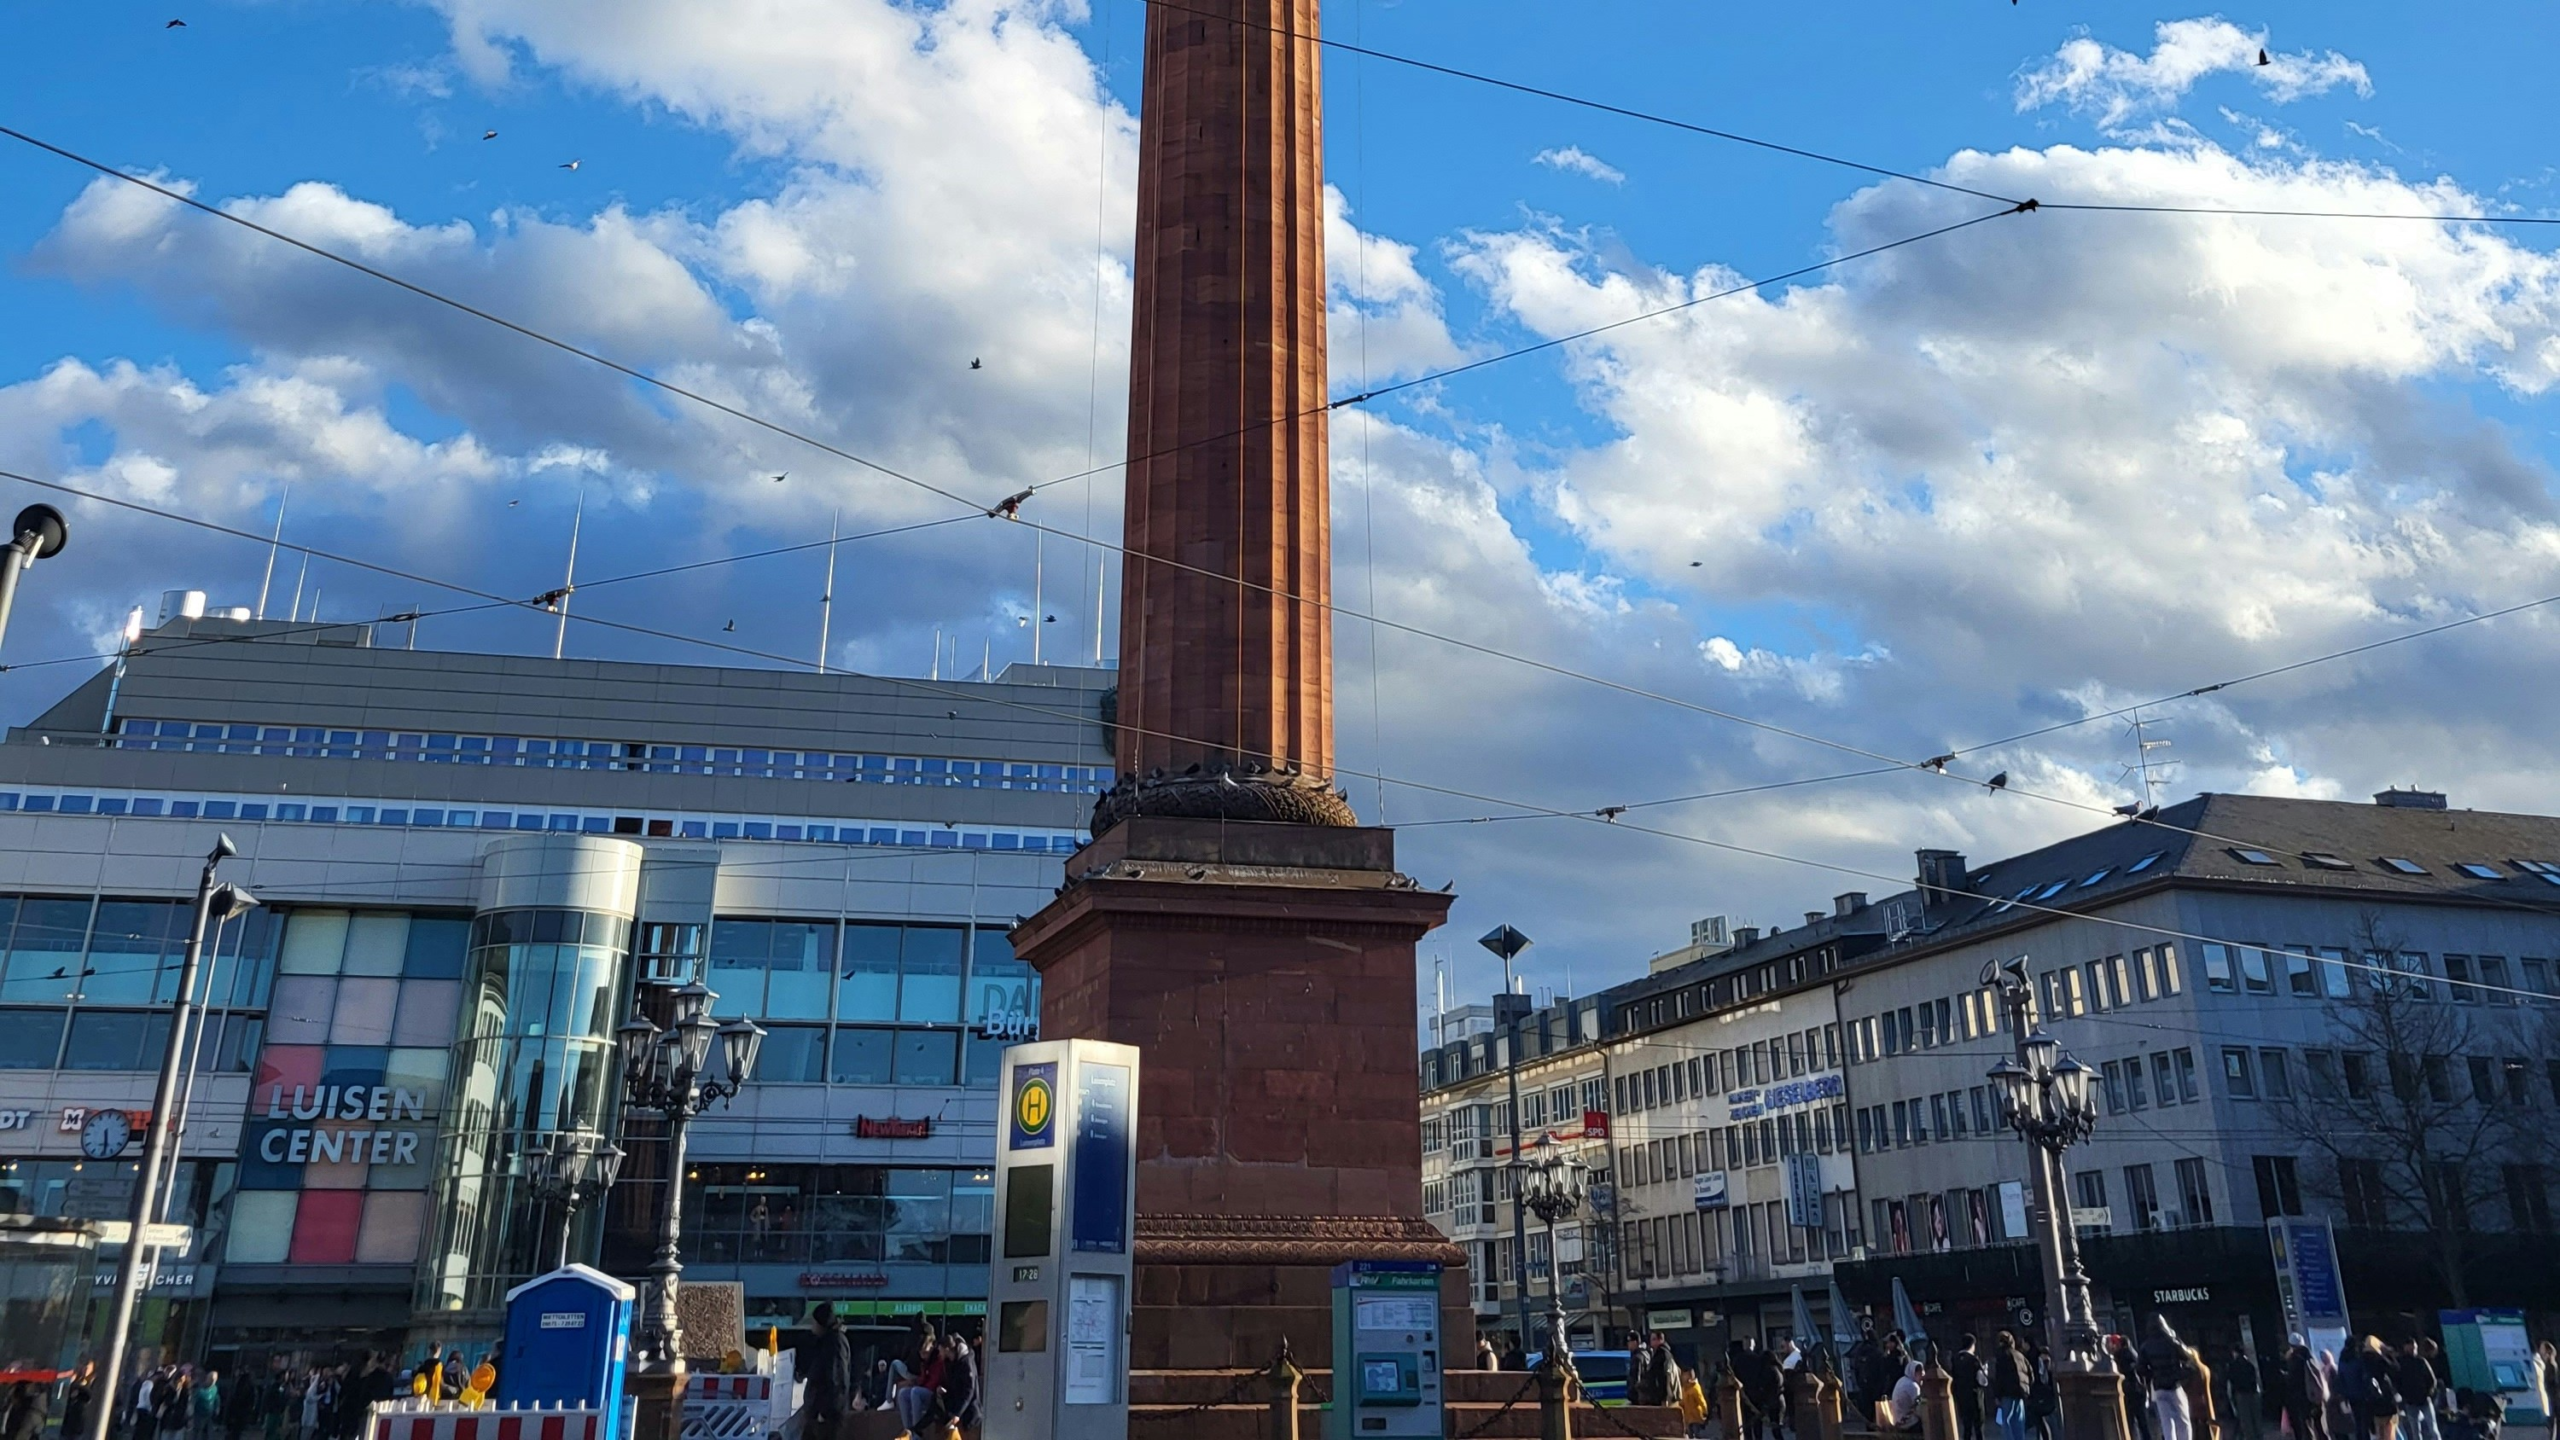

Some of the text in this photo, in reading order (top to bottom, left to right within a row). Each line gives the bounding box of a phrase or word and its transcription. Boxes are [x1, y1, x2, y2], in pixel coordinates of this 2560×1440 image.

[984, 1009, 1041, 1041] Bür
[268, 1085, 427, 1121] LUISEN
[1027, 1091, 1042, 1122] H
[260, 1128, 419, 1164] CENTER
[1588, 1127, 1605, 1137] SPD
[2153, 1286, 2210, 1304] STARBUCKS
